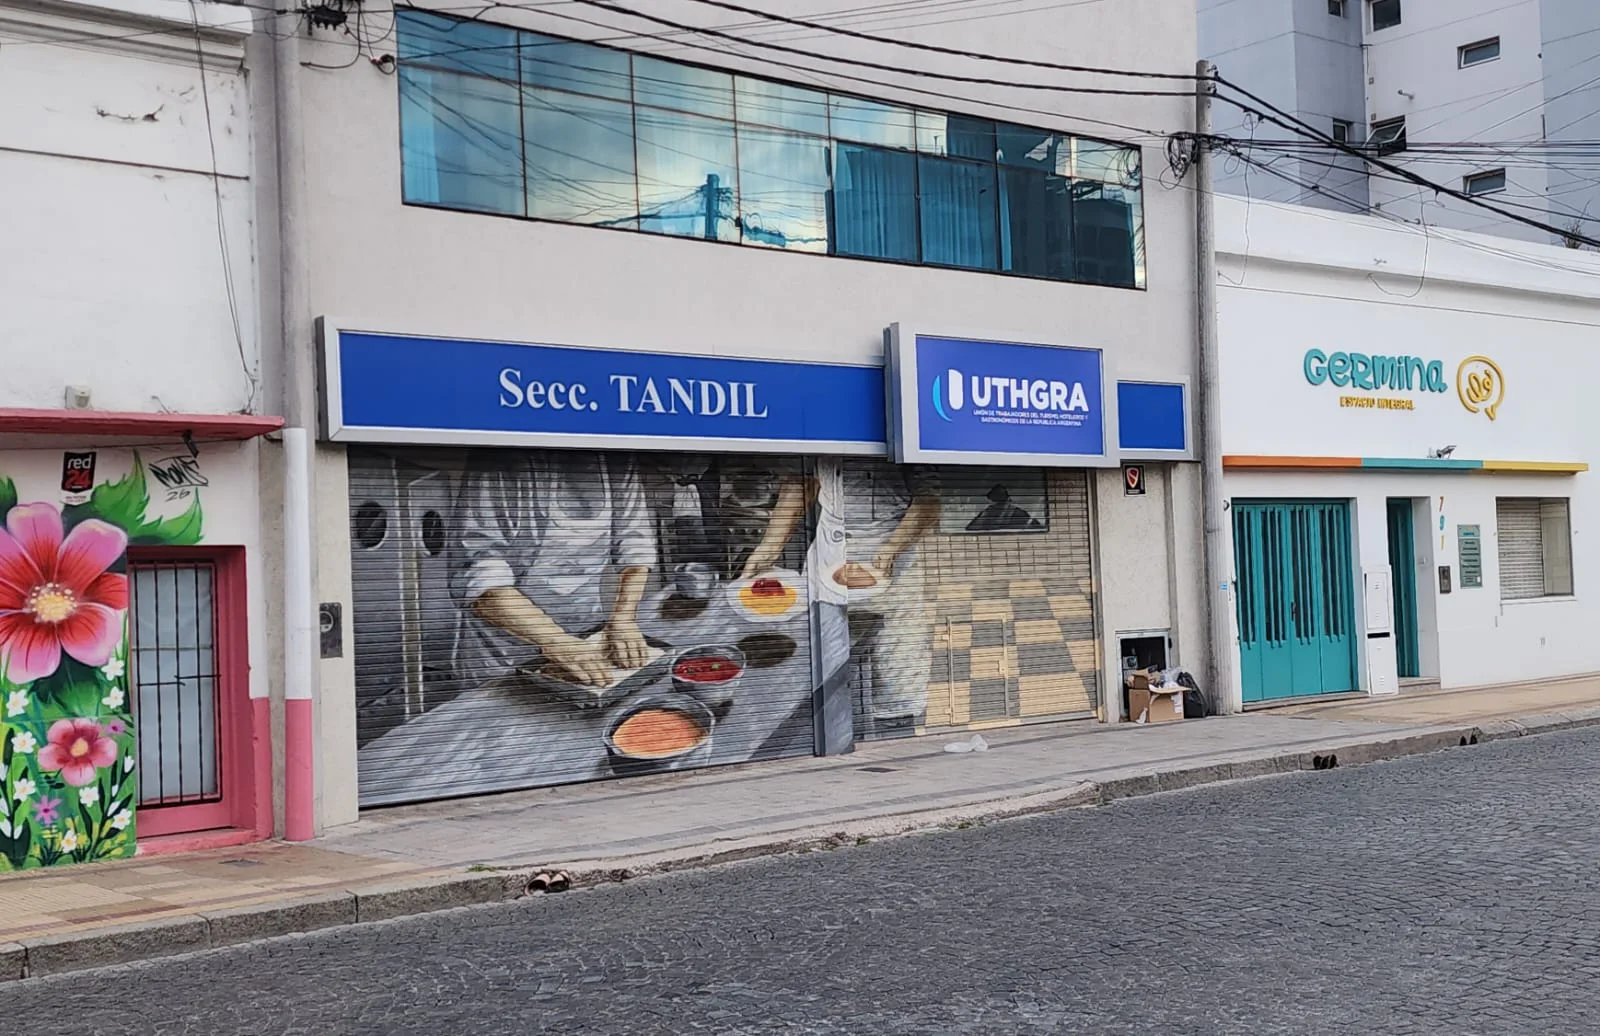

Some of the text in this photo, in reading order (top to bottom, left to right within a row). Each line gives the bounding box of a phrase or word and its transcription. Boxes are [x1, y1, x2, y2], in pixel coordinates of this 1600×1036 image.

[499, 367, 769, 419] Secc. TANDIL
[971, 375, 1089, 412] UTHGRA
[67, 454, 92, 470] red
[64, 468, 91, 490] 24
